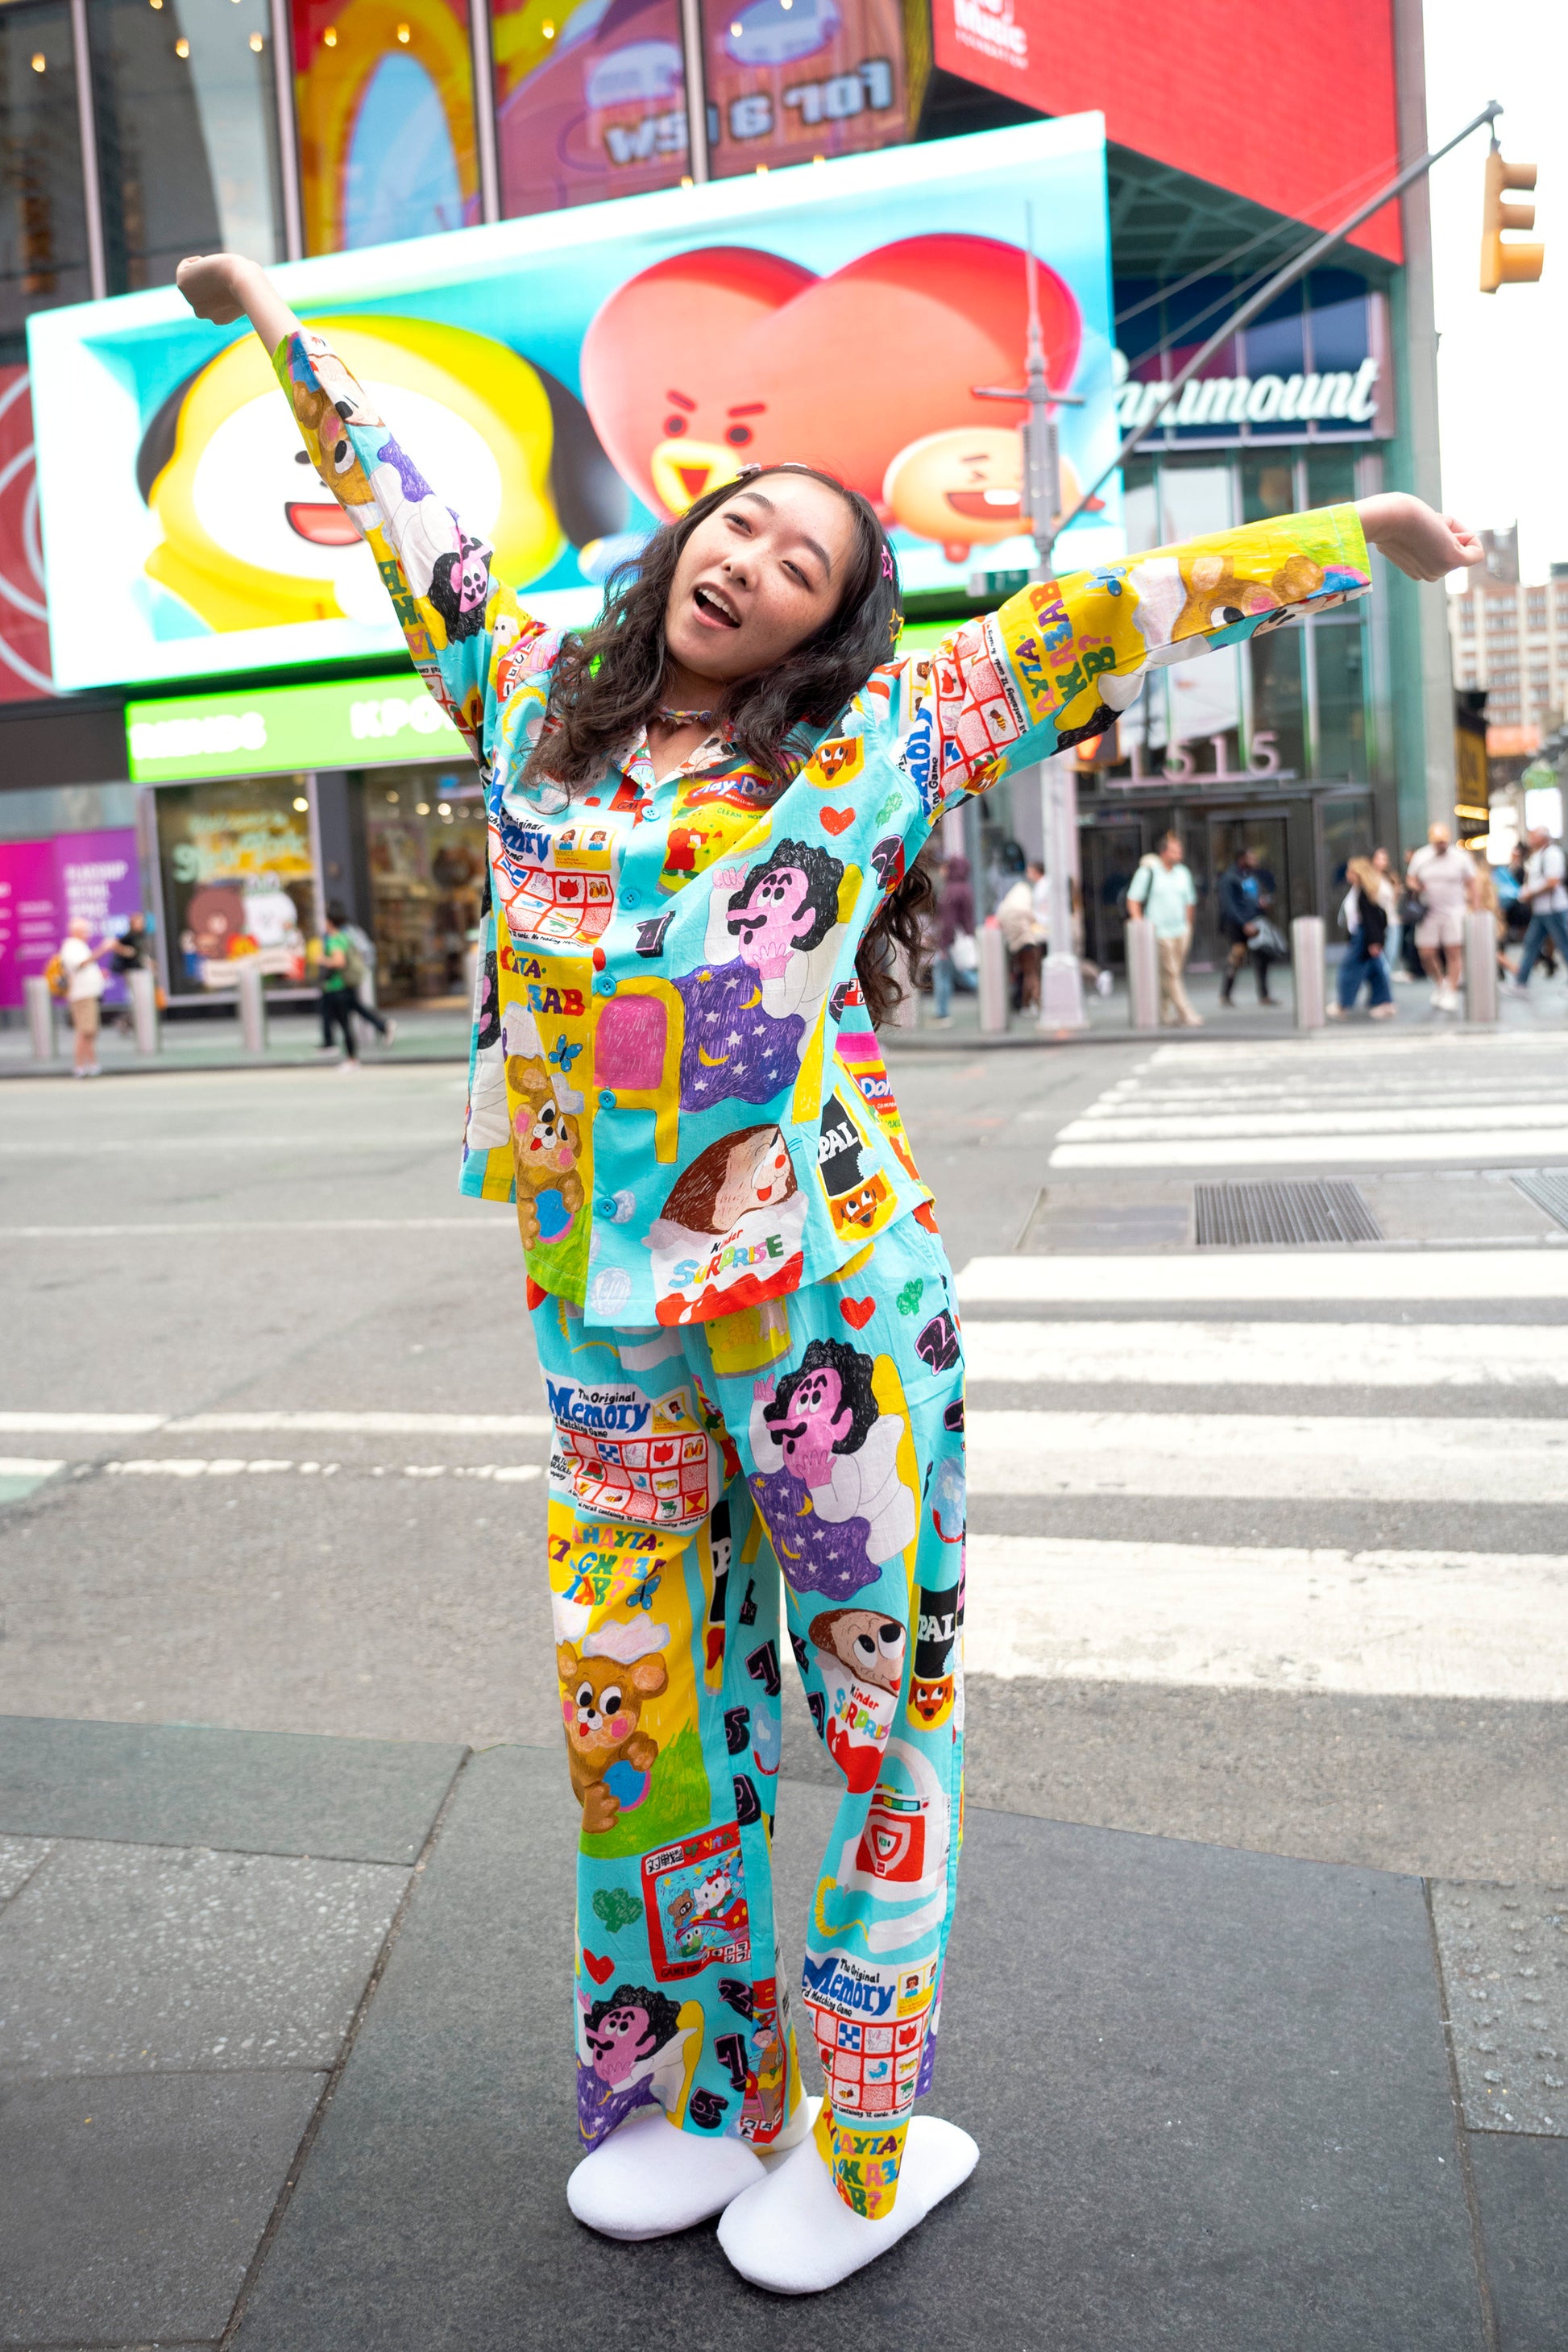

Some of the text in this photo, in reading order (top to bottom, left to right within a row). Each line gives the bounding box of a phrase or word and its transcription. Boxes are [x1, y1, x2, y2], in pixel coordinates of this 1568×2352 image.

[1130, 730, 1281, 784] 1515
[818, 1121, 860, 1164] PAL
[546, 1379, 651, 1433] Memory
[591, 1391, 636, 1405] Original
[588, 1428, 608, 1438] Game
[918, 1612, 956, 1642] PAL
[802, 1954, 896, 2017] Memory
[851, 1964, 880, 1984] Original
[836, 2002, 853, 2018] Game
